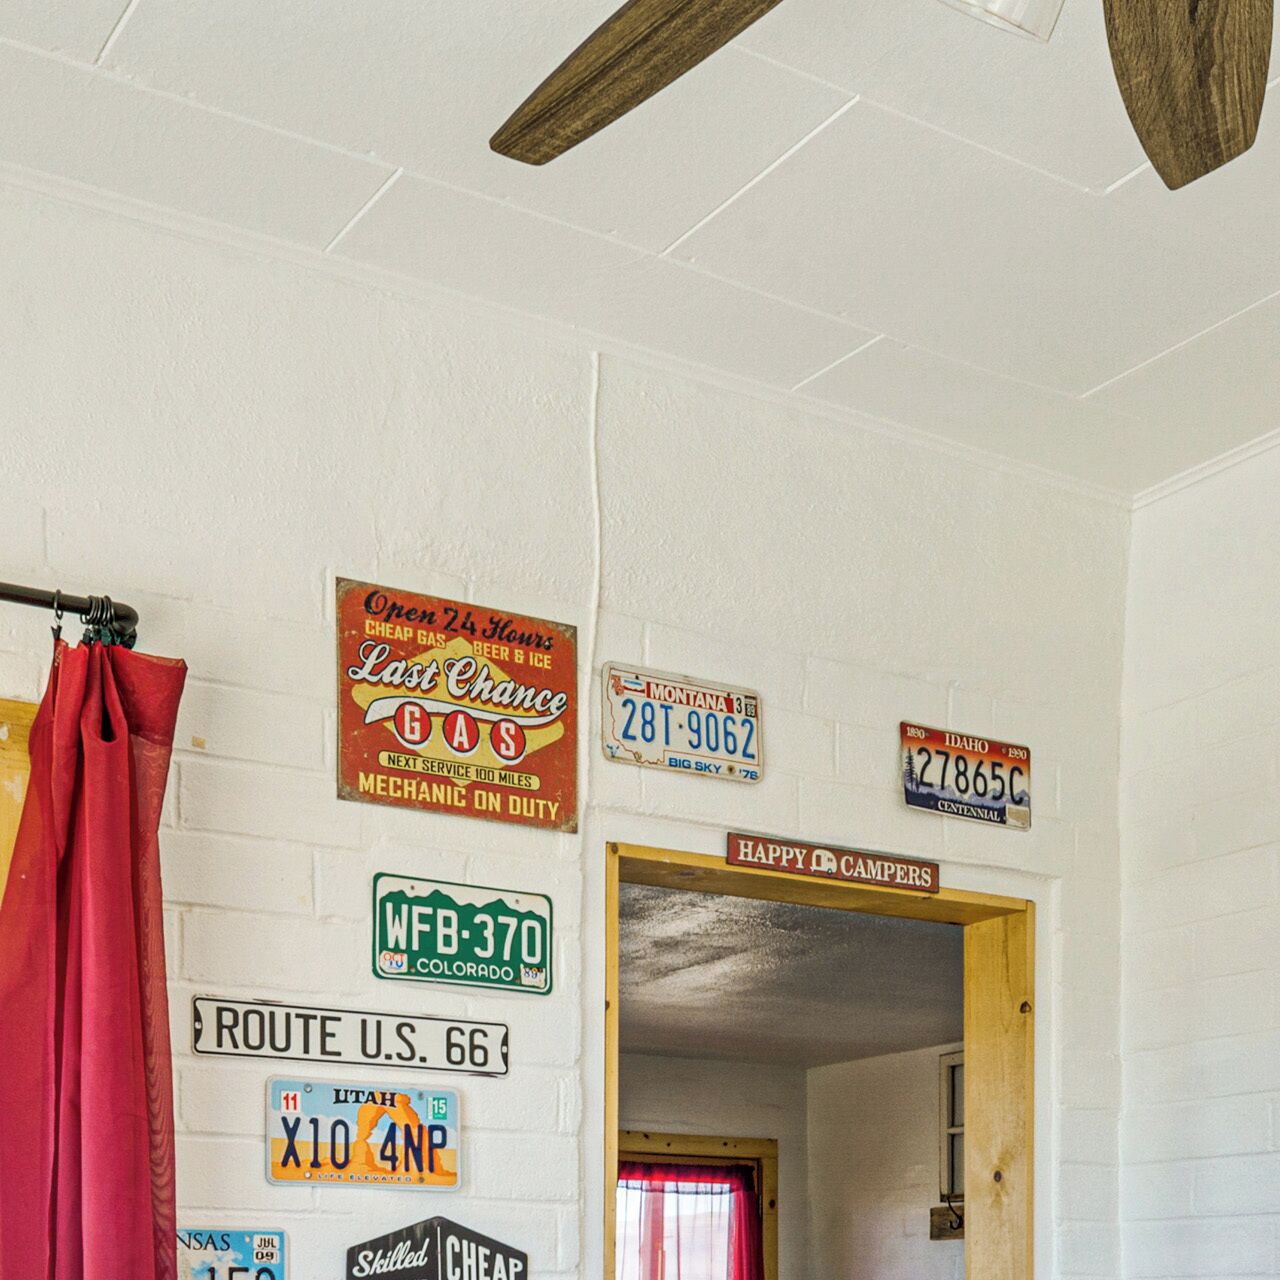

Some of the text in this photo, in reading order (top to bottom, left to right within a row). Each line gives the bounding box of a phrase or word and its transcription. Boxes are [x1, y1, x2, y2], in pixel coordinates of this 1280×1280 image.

[364, 590, 554, 650] Open 24 Hours
[365, 620, 552, 669] CHEAP GAS BEER & ICE
[347, 640, 567, 715] Last Chance
[650, 683, 727, 713] MONTANA
[736, 697, 742, 714] 3
[944, 733, 989, 754] IDAHO
[1008, 747, 1027, 760] 1990
[388, 755, 532, 788] NEXT SERVICE 100 MILES
[668, 757, 692, 769] BIG
[694, 761, 722, 774] SKY
[917, 747, 1024, 805] 27865C
[358, 772, 559, 820] MECHANIC ON DUTY
[938, 800, 1000, 822] CENTENNIAL
[737, 839, 932, 888] HAPPY CAMPERS
[417, 958, 514, 981] COLORADO
[216, 1006, 489, 1067] ROUTE U.S. 66
[283, 1092, 298, 1111] 11
[333, 1088, 397, 1108] UTAH
[432, 1099, 446, 1114] 15
[281, 1116, 447, 1173] X10 4NP
[350, 1174, 412, 1183] ELEVATED
[255, 1252, 274, 1260] 09
[352, 1237, 430, 1277] Skilled
